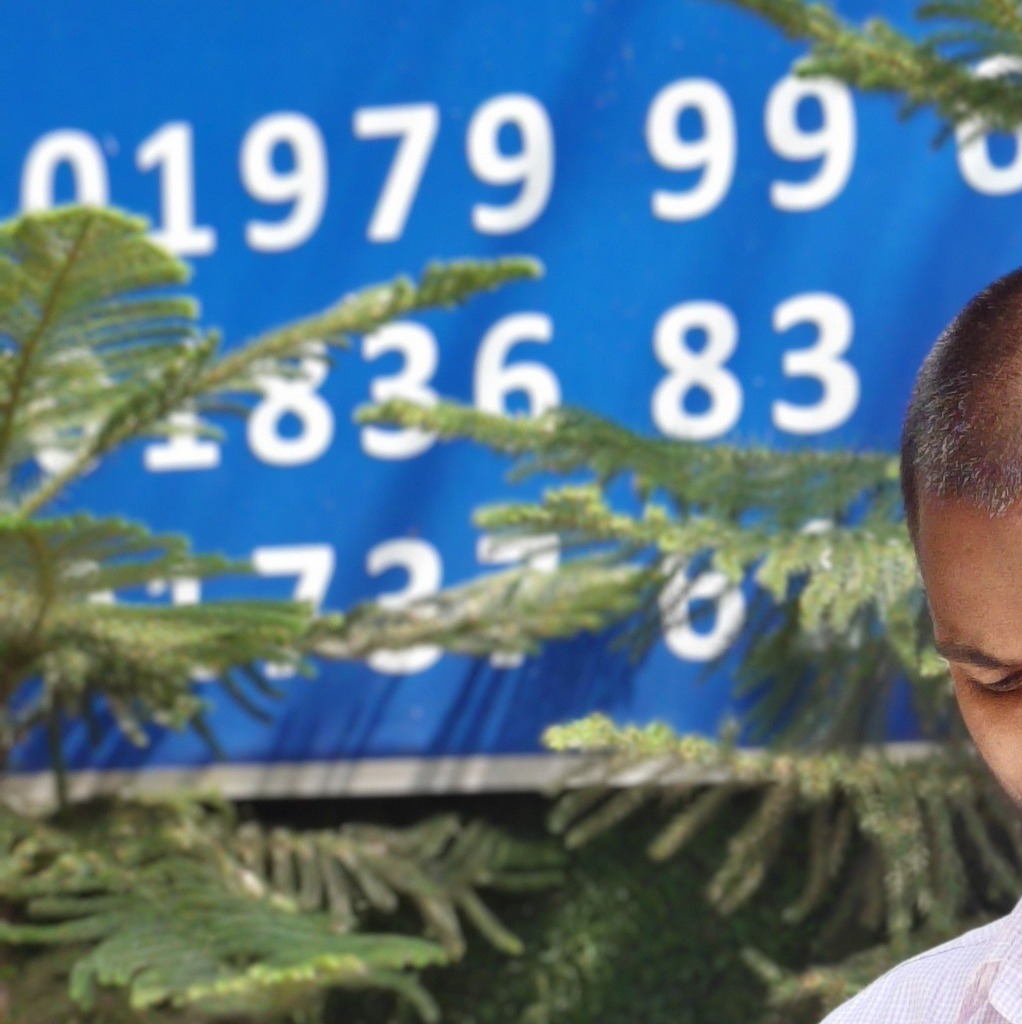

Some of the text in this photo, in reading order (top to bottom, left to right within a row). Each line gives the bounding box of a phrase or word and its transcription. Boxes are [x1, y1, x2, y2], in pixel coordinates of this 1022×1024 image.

[20, 93, 556, 264] 01979
[646, 74, 859, 221] 99
[651, 292, 860, 441] 83
